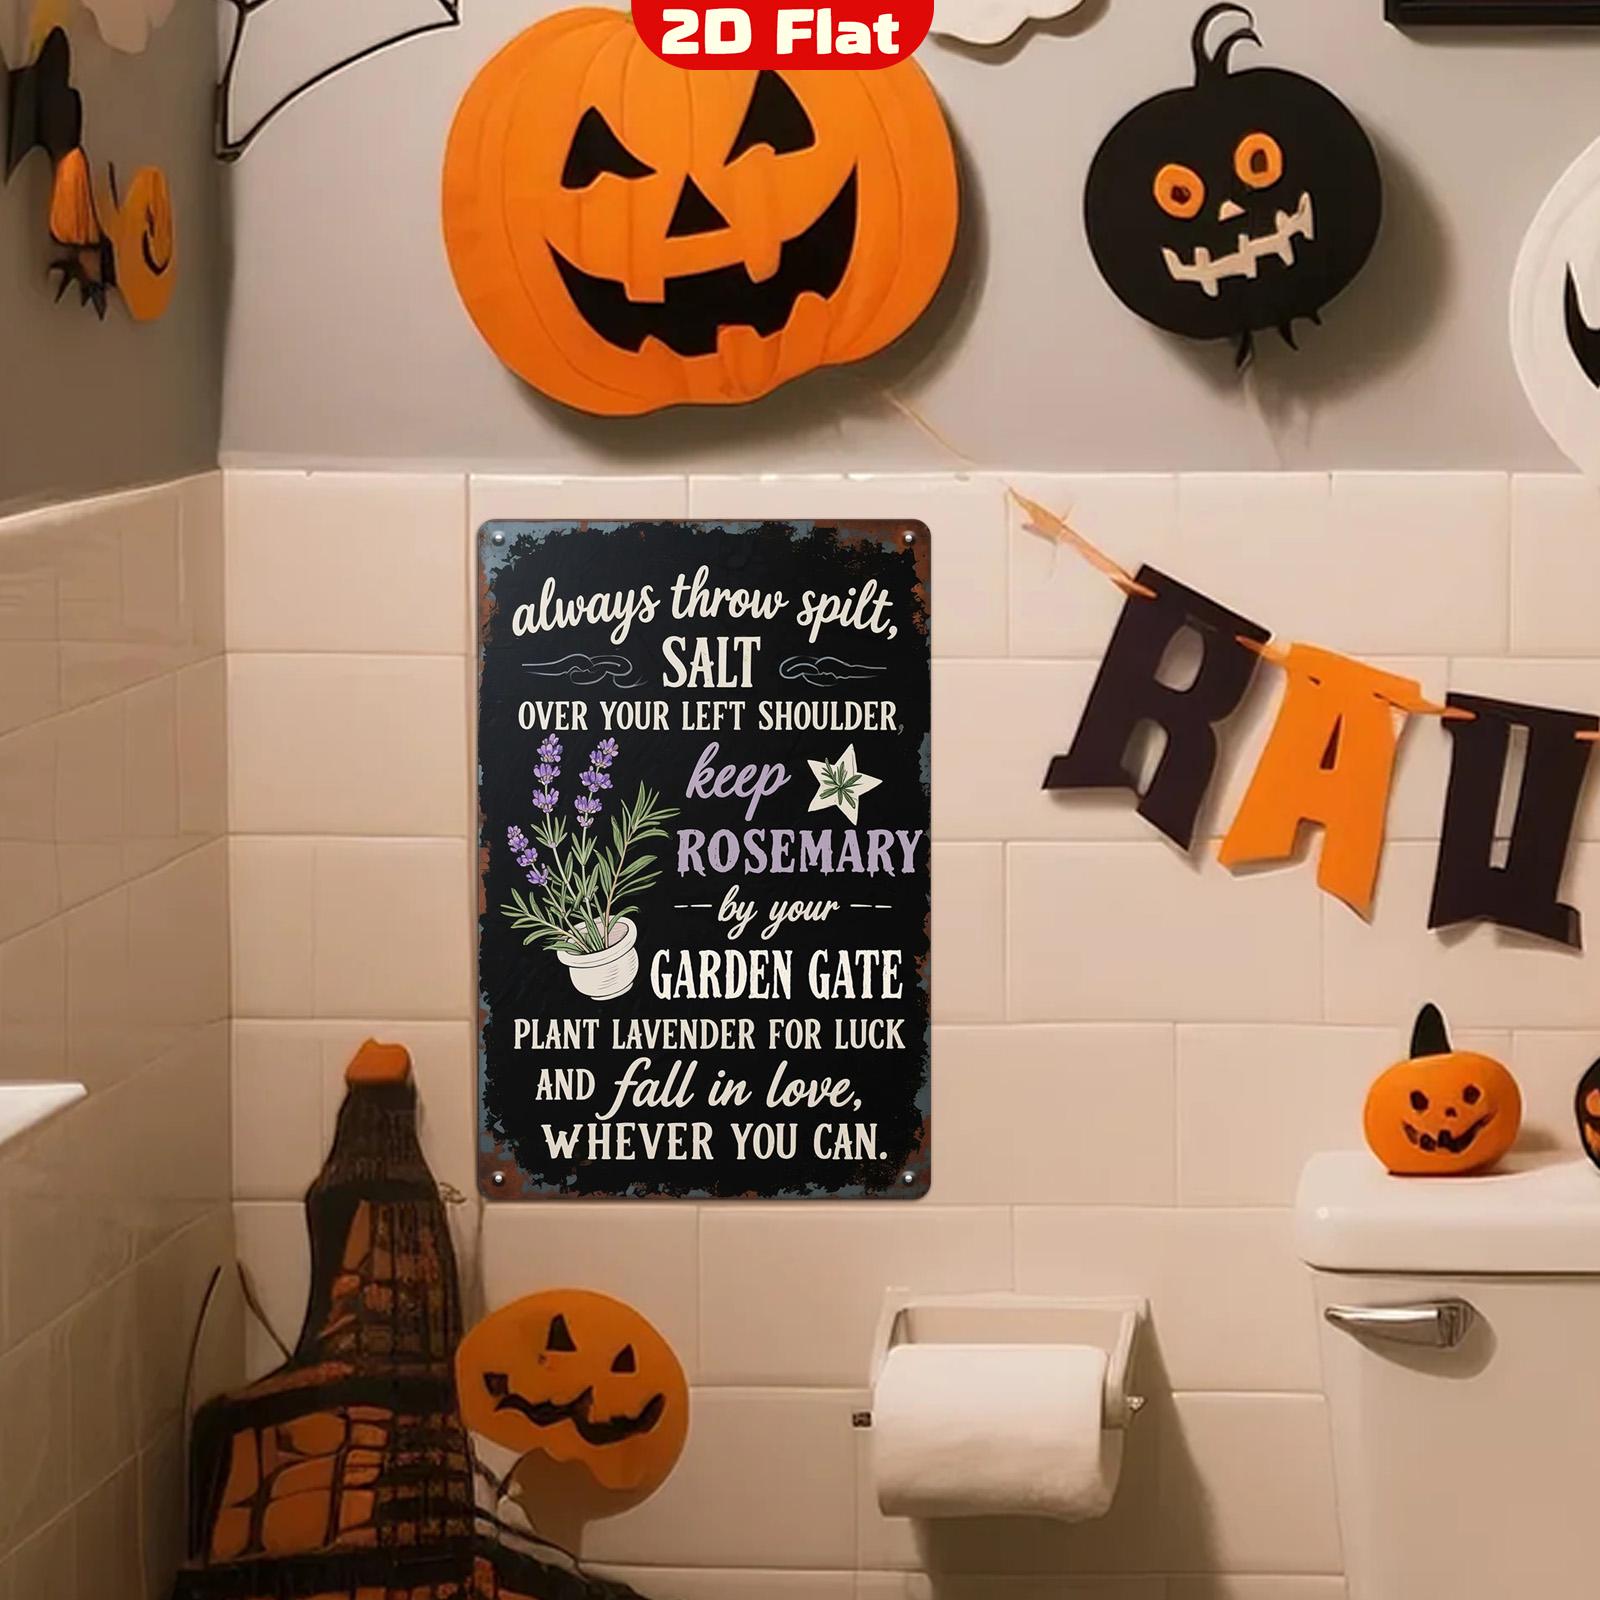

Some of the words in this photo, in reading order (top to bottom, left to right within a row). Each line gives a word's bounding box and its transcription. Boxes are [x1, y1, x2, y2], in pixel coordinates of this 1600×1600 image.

[512, 577, 661, 645] always
[671, 564, 790, 620] throw
[796, 578, 899, 644] spilt,
[661, 636, 761, 689] SALT
[518, 700, 588, 731] OVER
[600, 700, 670, 731] YOUR
[682, 700, 746, 731] LEFT
[686, 741, 791, 821] keep
[676, 829, 924, 878] ROSEMARY
[717, 884, 758, 940] by
[761, 899, 840, 939] your
[650, 949, 793, 1000] GARDEN
[808, 949, 904, 1000] GATE
[513, 1018, 600, 1050] PLANT
[612, 1018, 756, 1050] LAVENDER
[769, 1018, 822, 1050] FOR
[835, 1018, 906, 1050] LUCK
[535, 1068, 596, 1101] AND
[595, 1056, 699, 1121] fall
[708, 1070, 752, 1108] in
[766, 1060, 863, 1112] love,
[541, 1122, 714, 1160] WHEVER
[730, 1122, 798, 1160] YOU
[813, 1122, 888, 1160] CAN.
